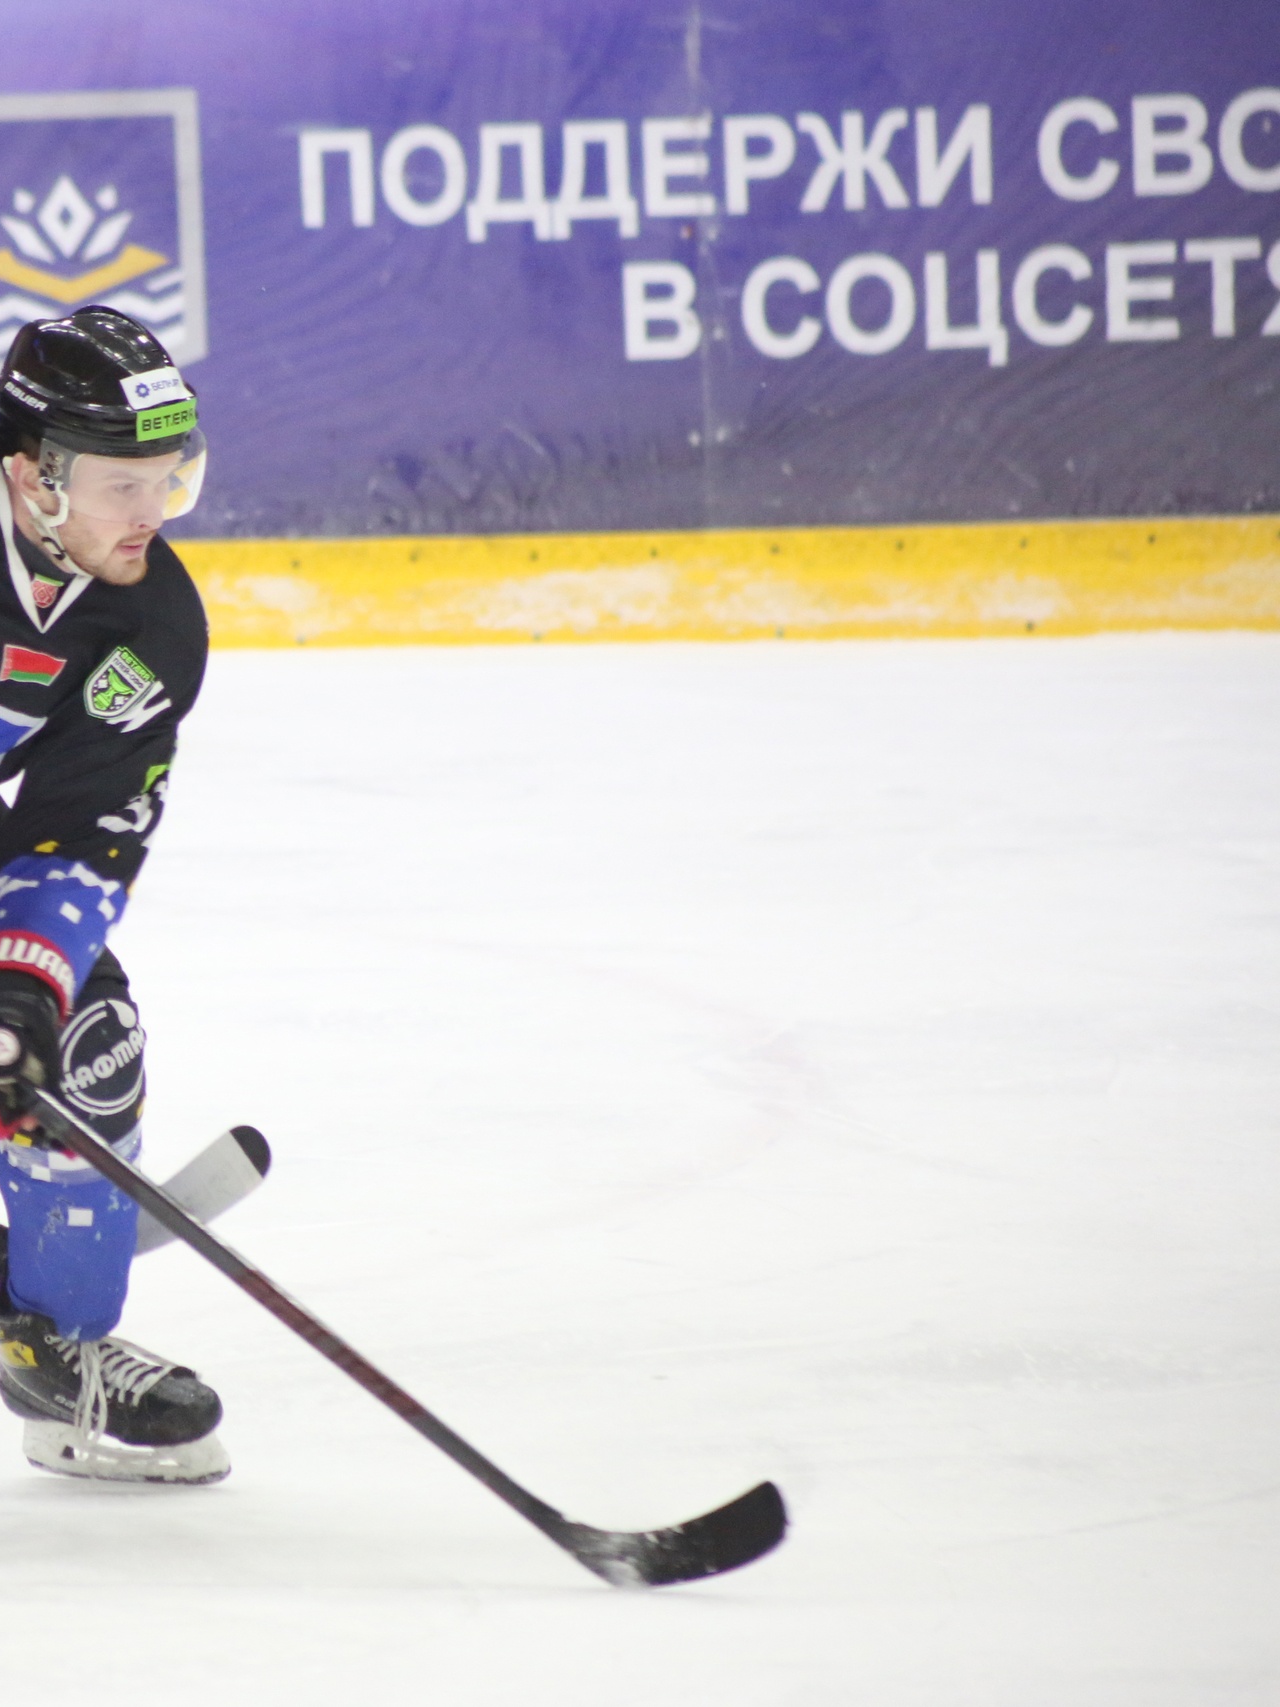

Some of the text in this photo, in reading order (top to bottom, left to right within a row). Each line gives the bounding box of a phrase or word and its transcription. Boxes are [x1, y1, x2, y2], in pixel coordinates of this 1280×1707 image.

[297, 103, 995, 244] ПОДДЕРЖИ
[621, 235, 1280, 369] В СОЦСЕТ
